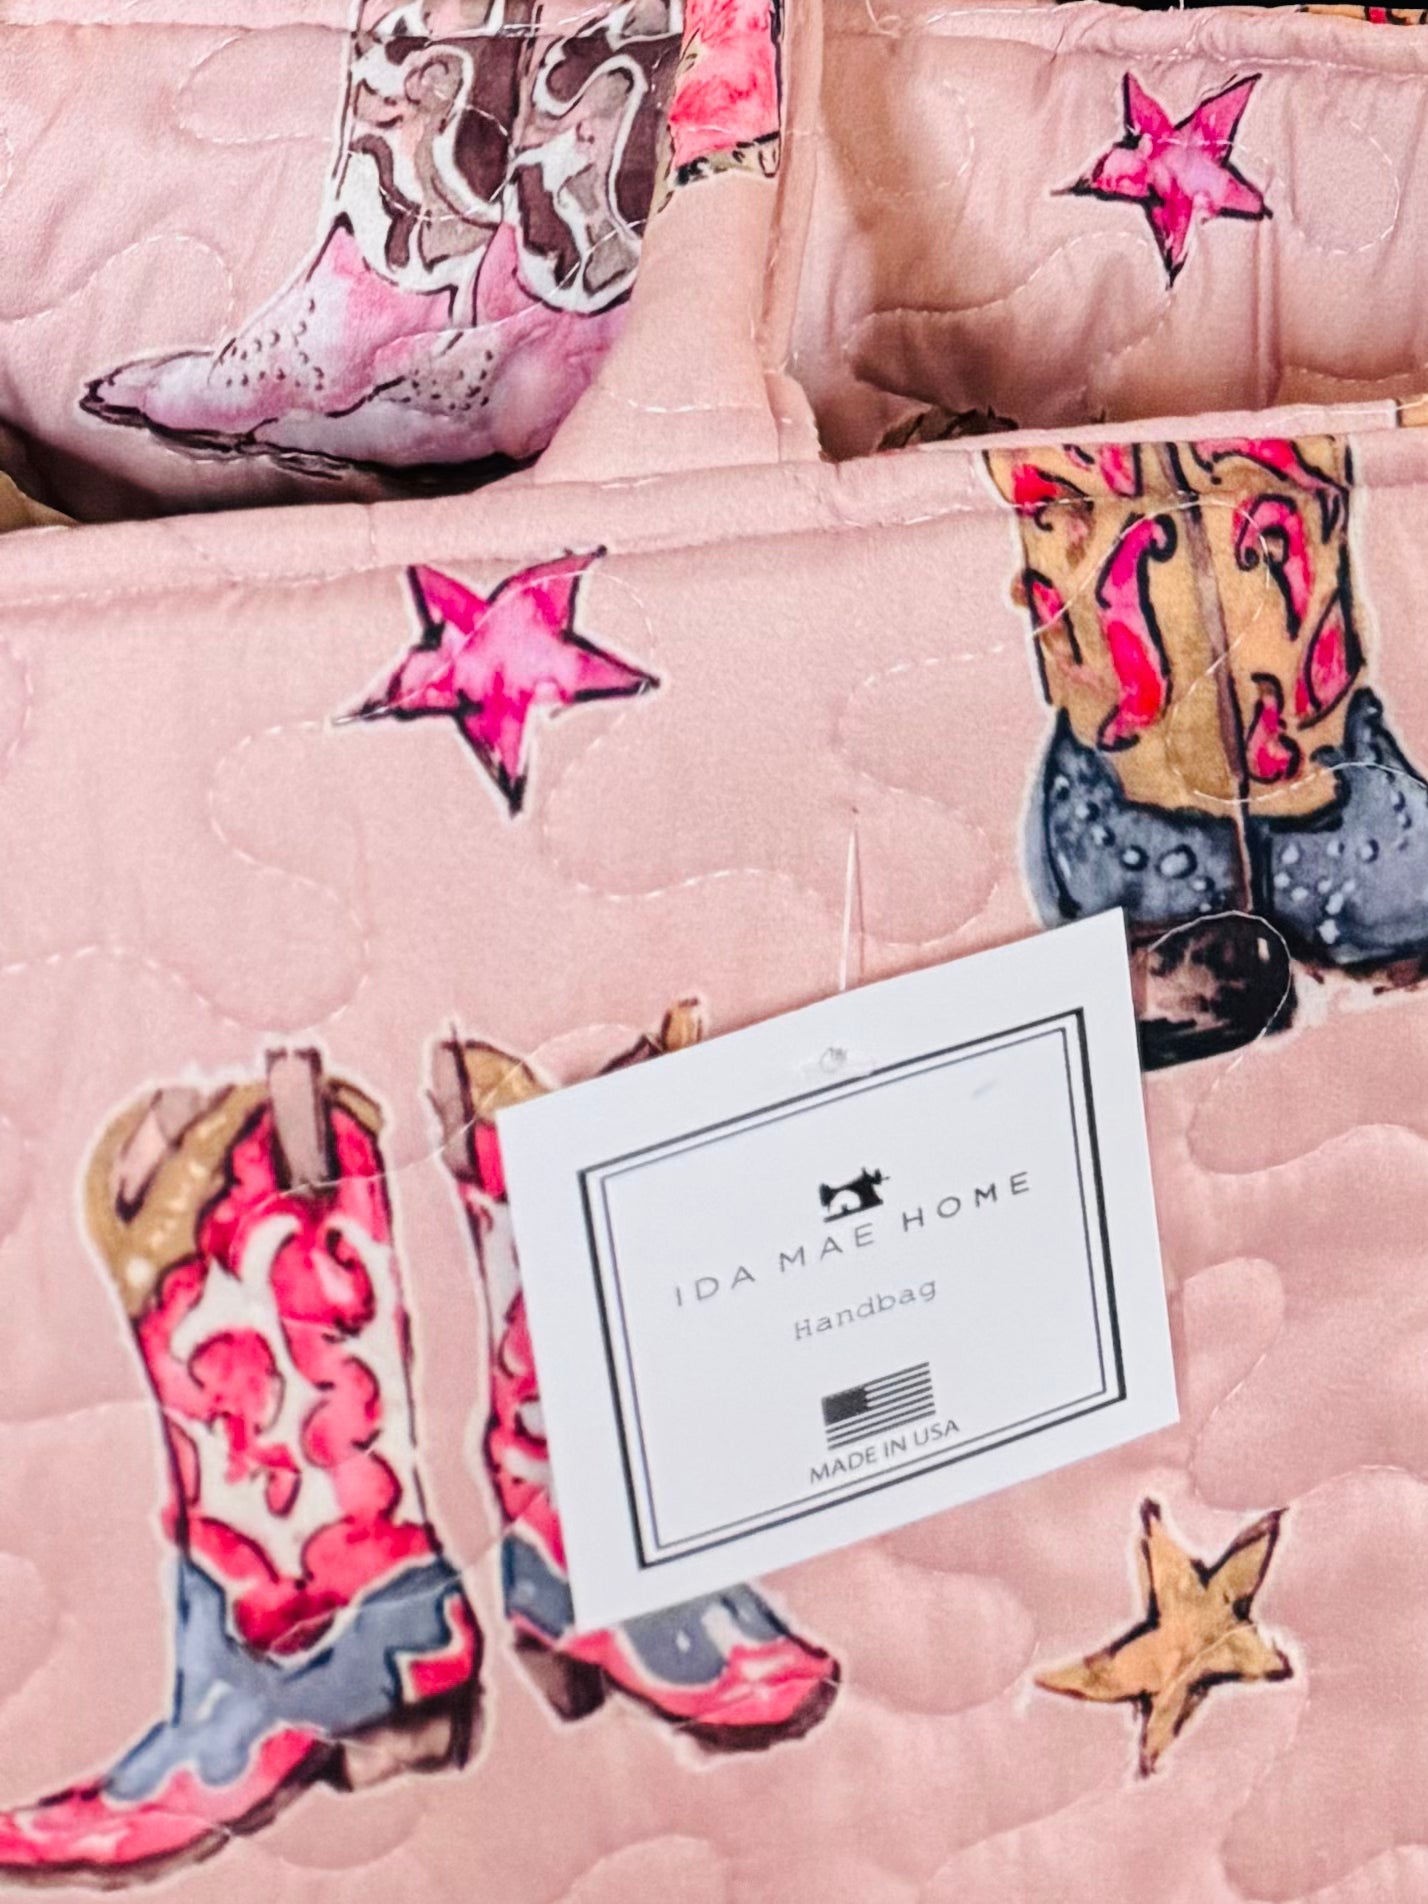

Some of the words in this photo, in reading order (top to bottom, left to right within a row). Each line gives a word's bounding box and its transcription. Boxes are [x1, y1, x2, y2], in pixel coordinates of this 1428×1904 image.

[675, 1265, 756, 1307] IDA
[778, 1222, 876, 1273] MAE
[902, 1170, 1031, 1232] HOME
[793, 1279, 939, 1341] Handbag
[809, 1446, 879, 1485] MADE
[883, 1434, 908, 1459] IN
[912, 1418, 961, 1446] USA
